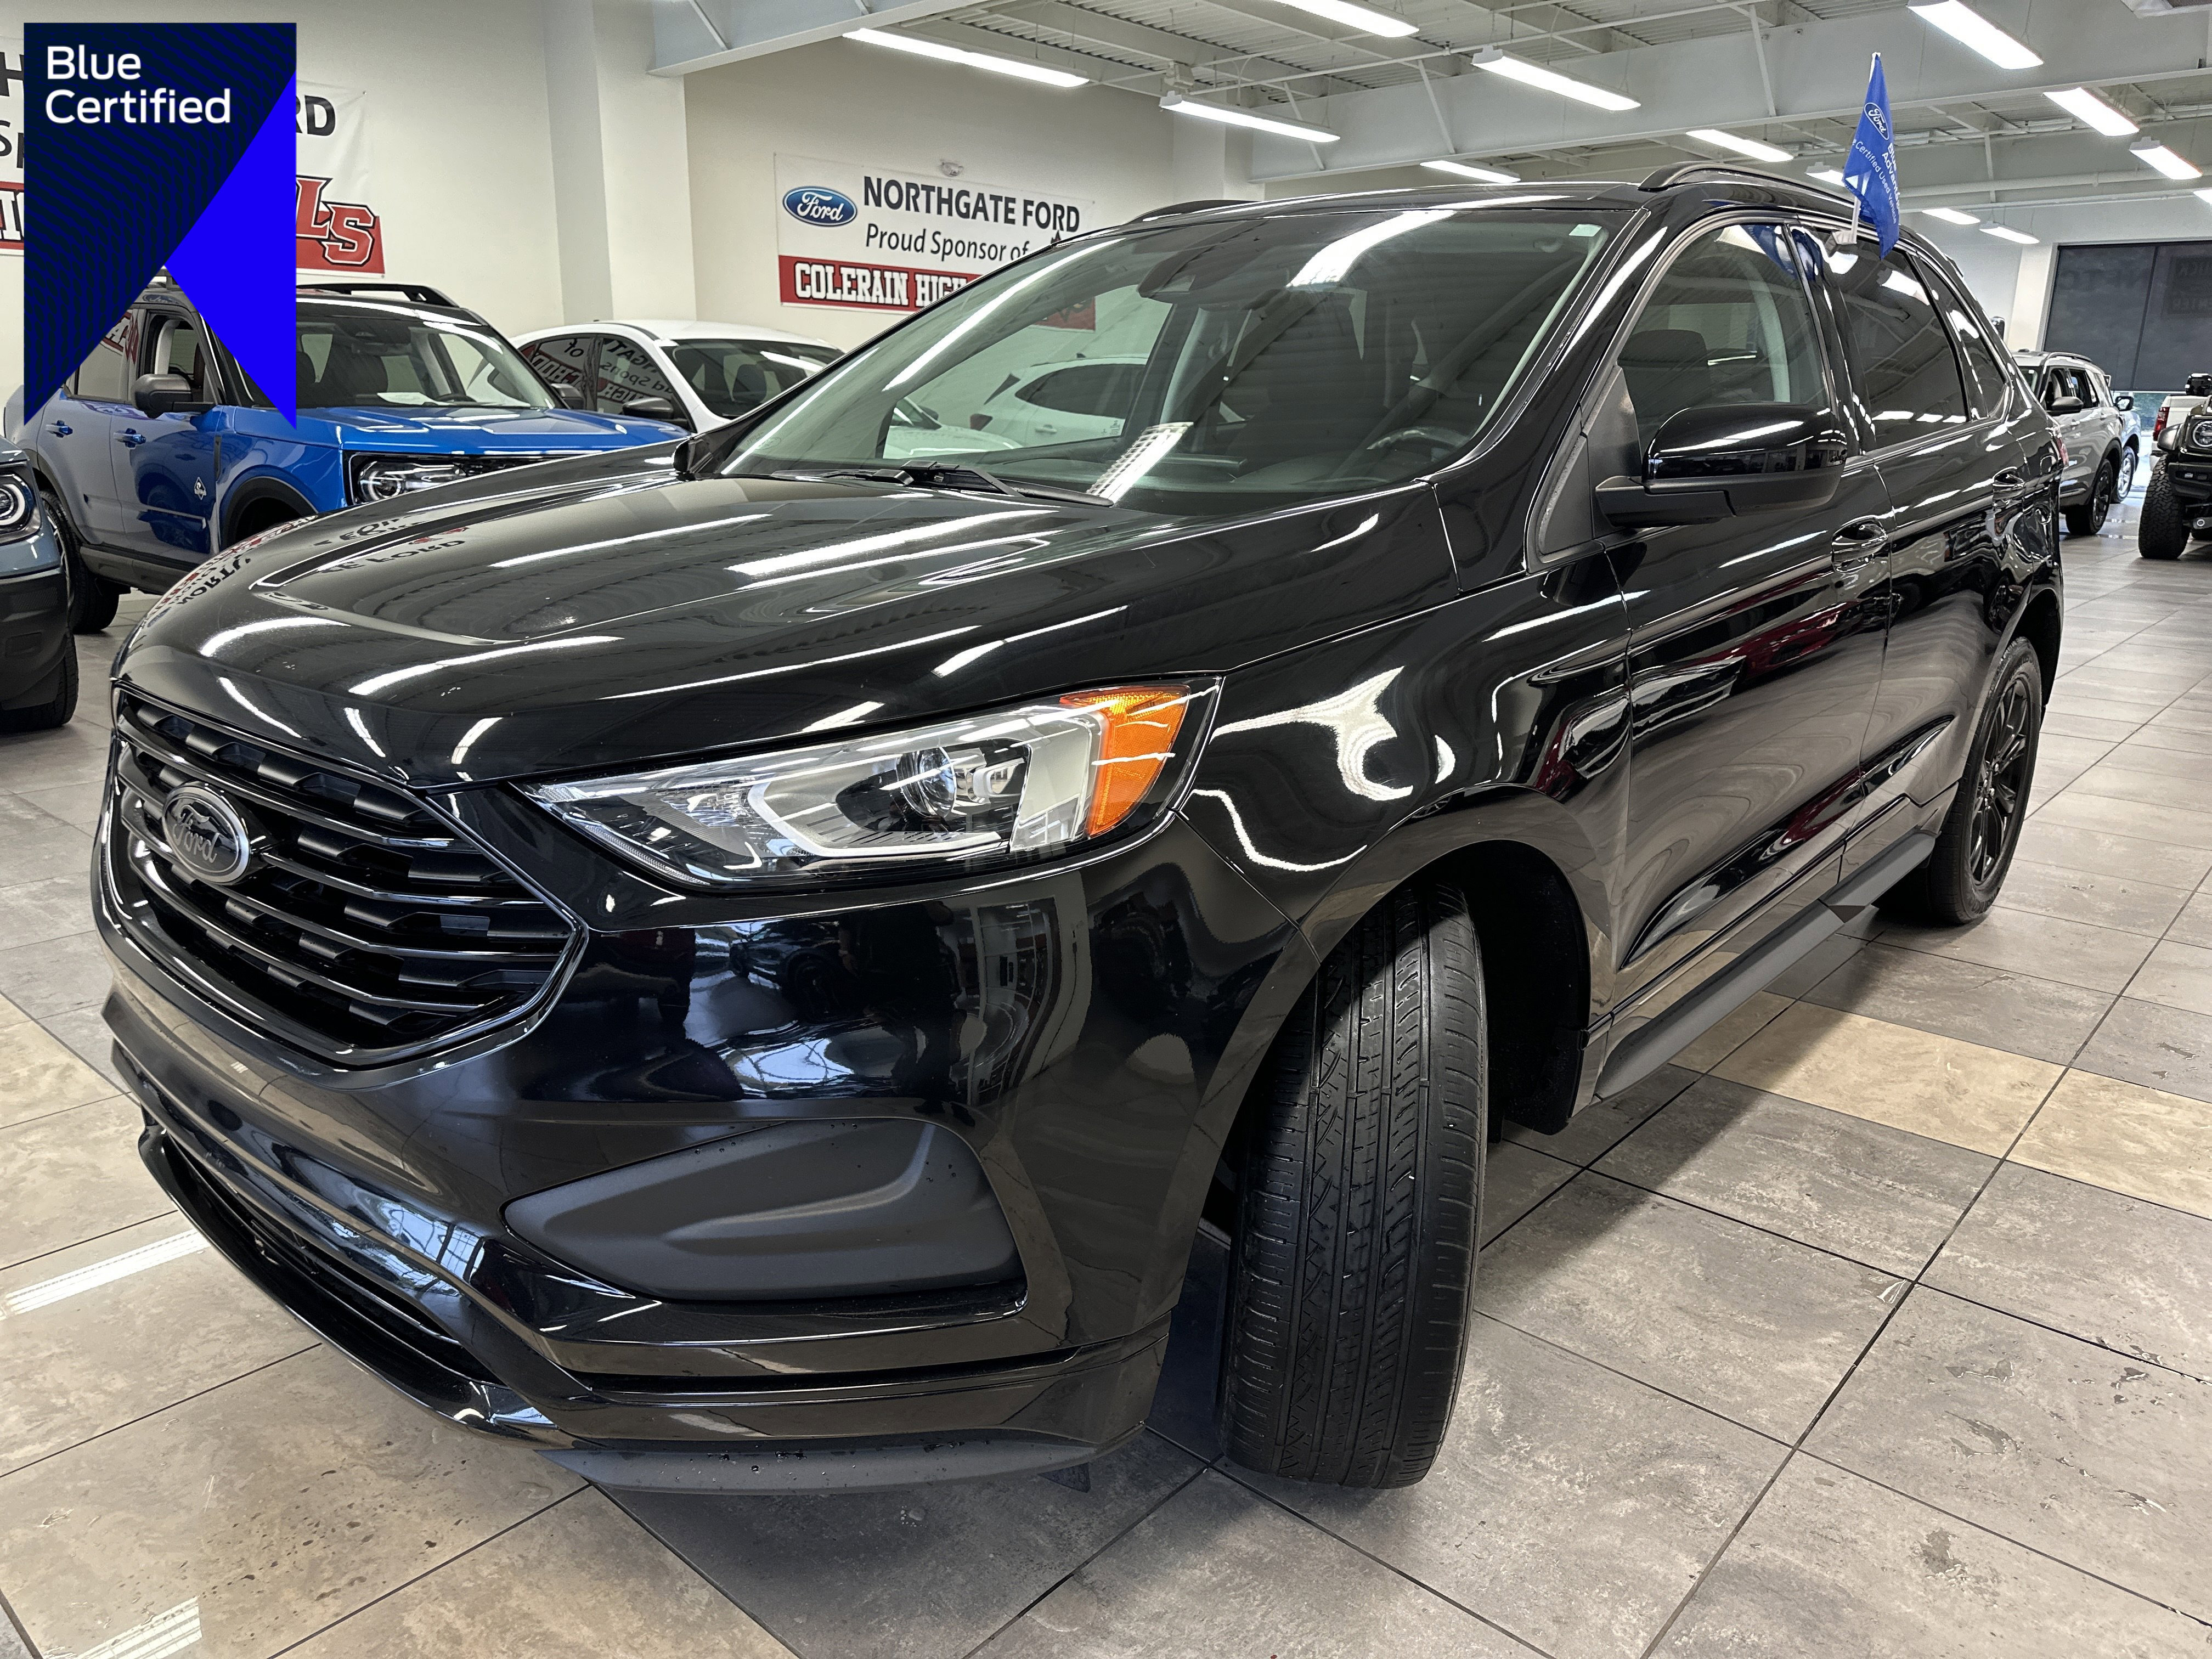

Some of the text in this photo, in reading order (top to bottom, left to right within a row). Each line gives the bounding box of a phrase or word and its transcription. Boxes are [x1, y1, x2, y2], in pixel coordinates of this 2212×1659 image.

[1868, 108, 1887, 133] Ford
[1855, 141, 1882, 173] Certified
[1878, 171, 1891, 194] Used
[797, 193, 845, 222] Ford
[864, 176, 1080, 233] NORTHGATE FORD
[866, 224, 926, 253] Proud
[931, 230, 1006, 262] Sponsor
[794, 262, 909, 306] COLERAIN
[172, 803, 217, 864] Ford
